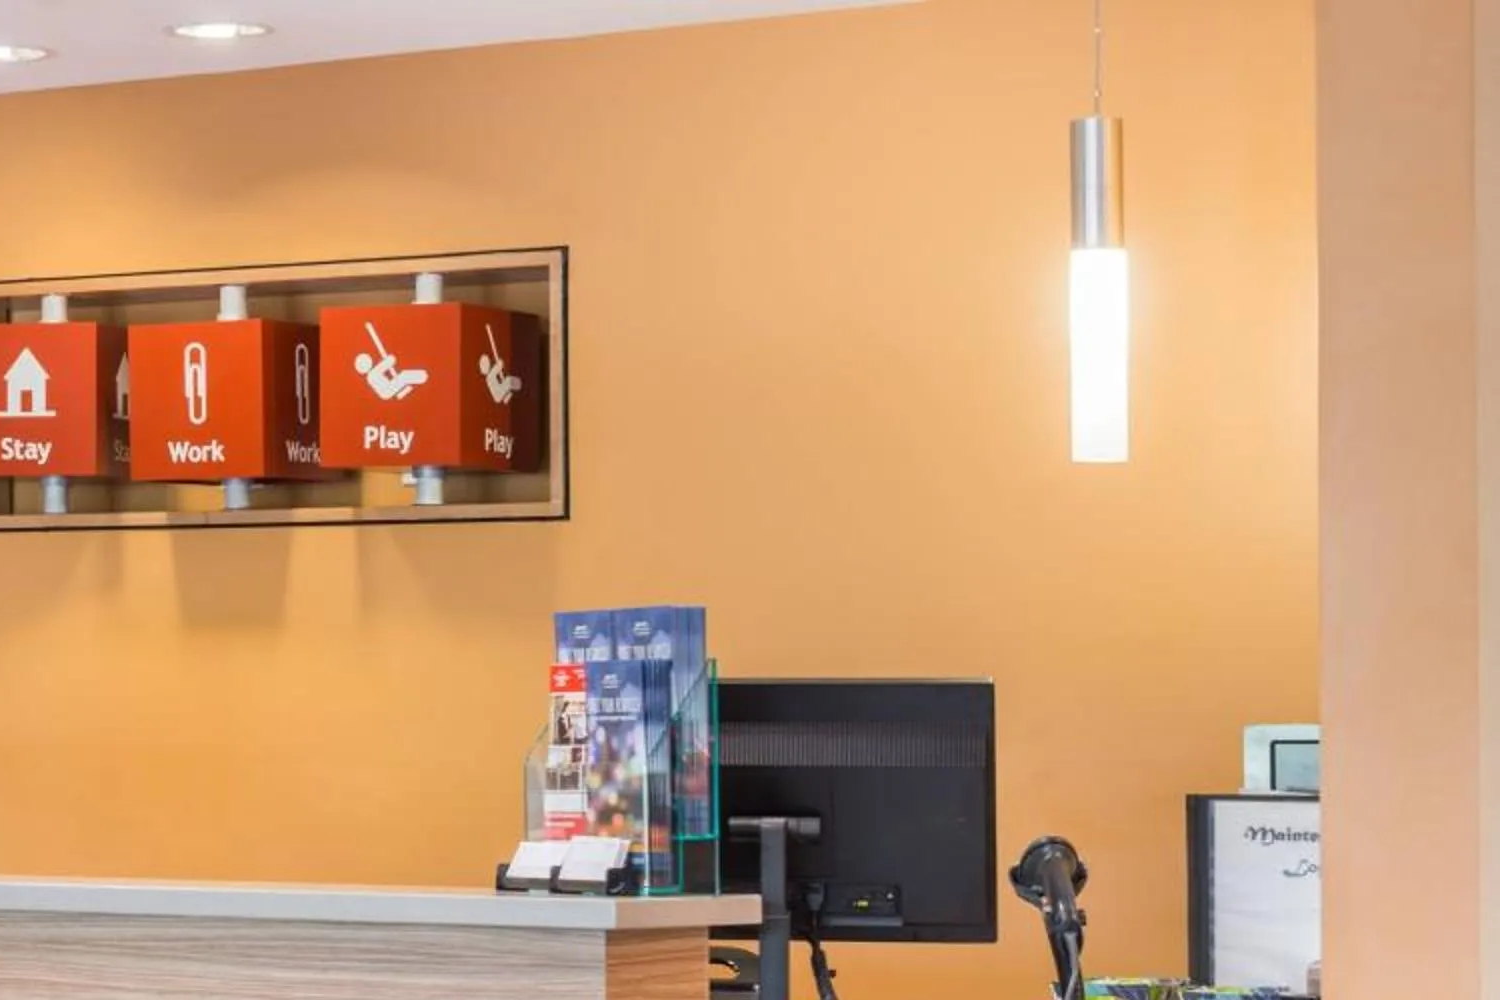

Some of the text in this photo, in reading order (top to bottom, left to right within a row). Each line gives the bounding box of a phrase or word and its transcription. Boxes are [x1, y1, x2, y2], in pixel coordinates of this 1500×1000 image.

[114, 439, 130, 462] Sta
[168, 439, 225, 463] Work
[364, 425, 414, 454] Play
[485, 428, 514, 458] Play
[1, 438, 51, 465] Stay
[286, 440, 321, 463] Work
[1243, 825, 1320, 846] Mainte
[1283, 859, 1318, 877] Lo
